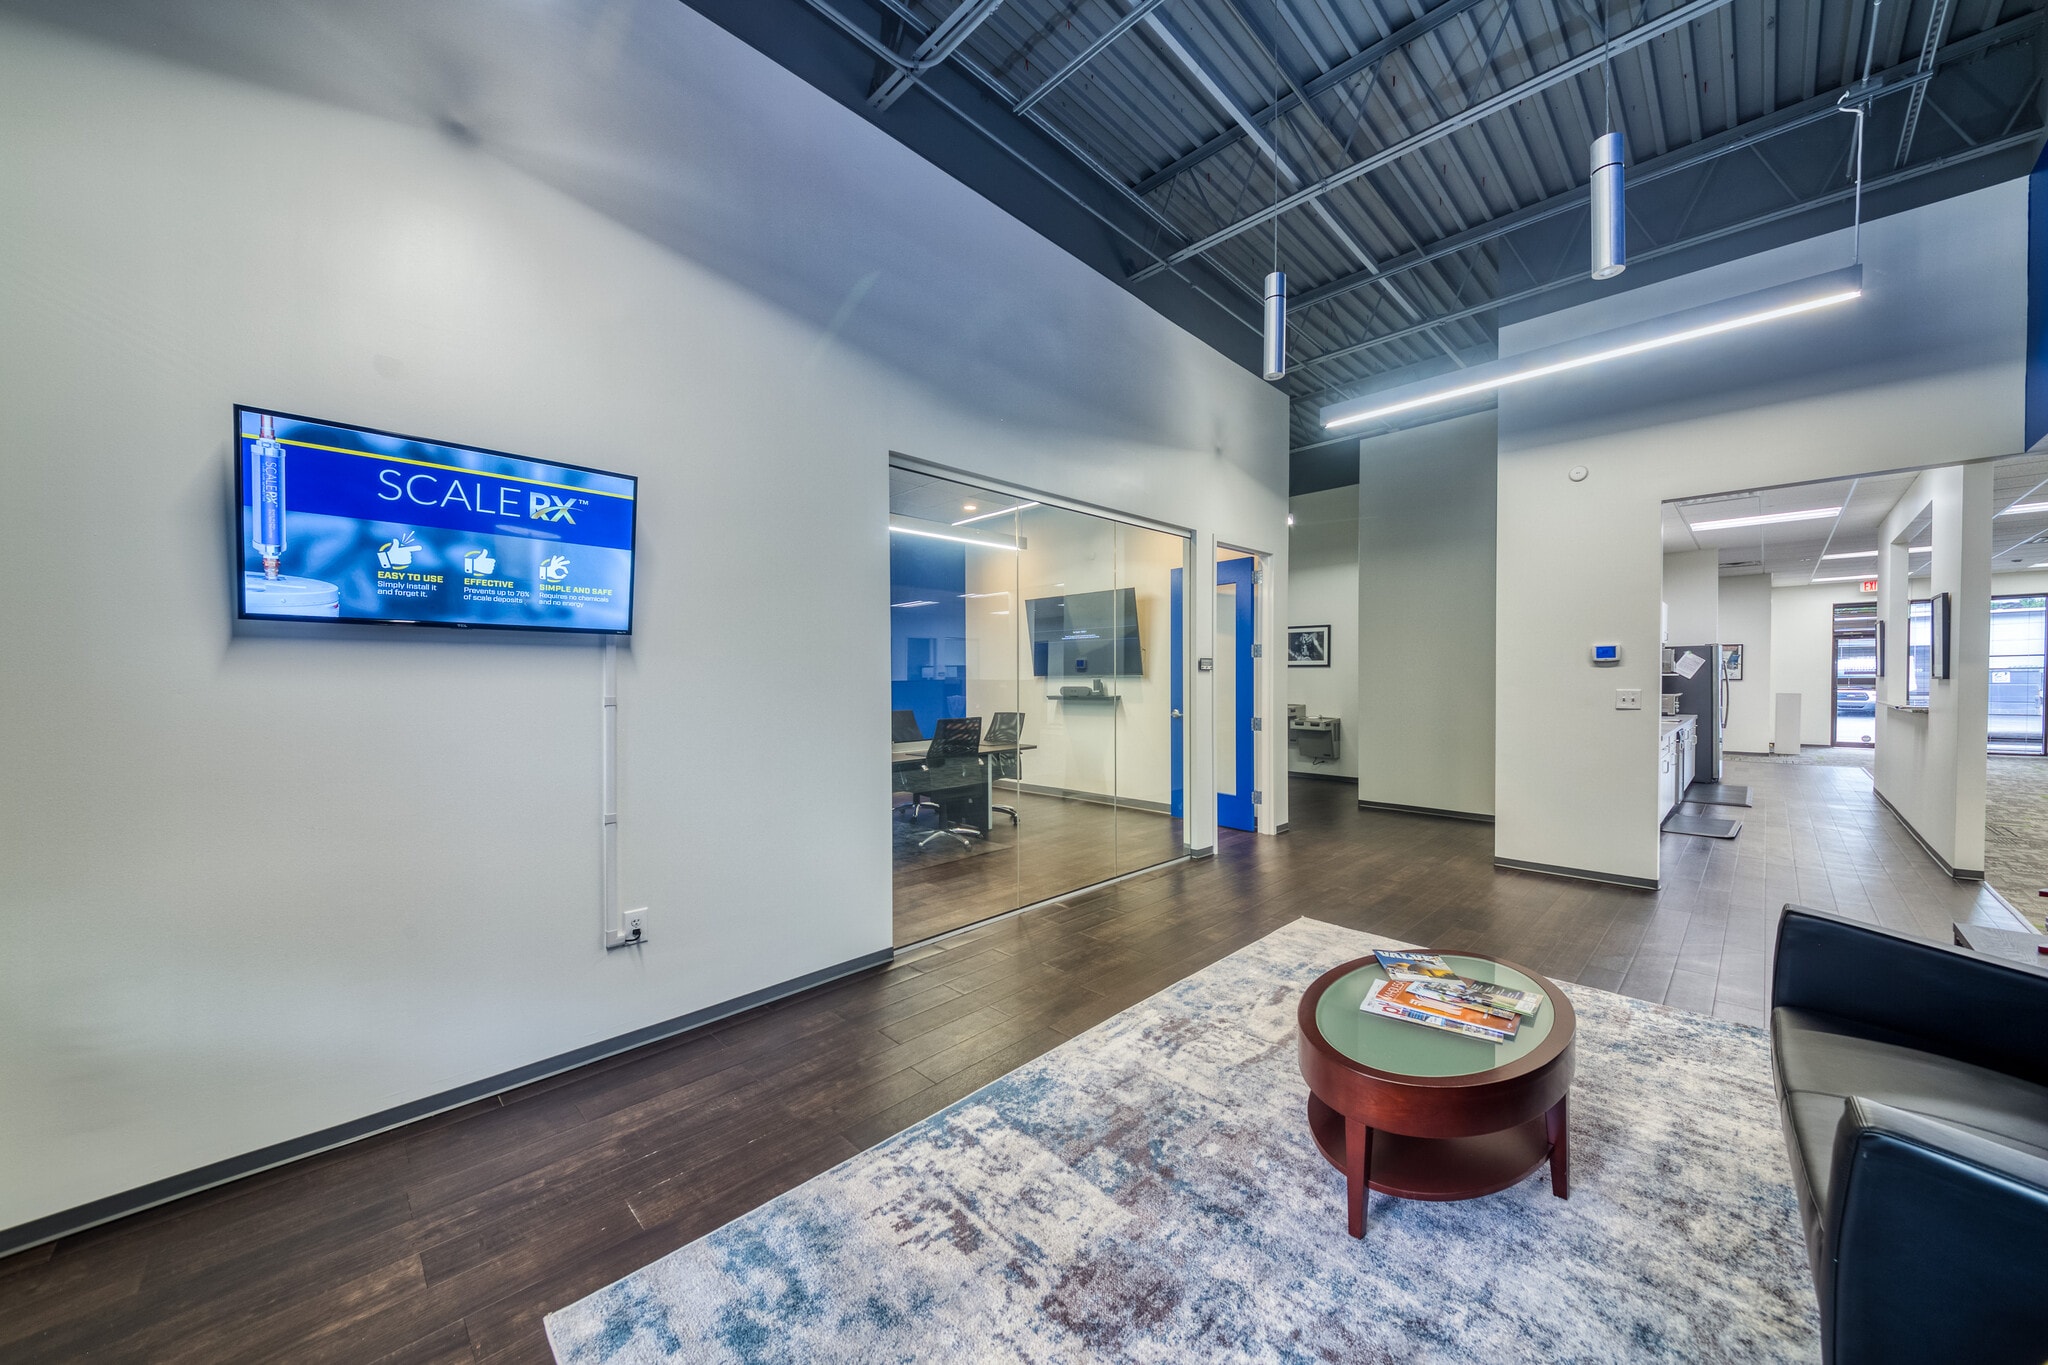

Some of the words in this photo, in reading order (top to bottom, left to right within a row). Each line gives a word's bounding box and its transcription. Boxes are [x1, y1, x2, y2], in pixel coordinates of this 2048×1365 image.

[377, 571, 405, 580] EASY
[407, 573, 421, 581] TO
[423, 574, 444, 583] USE
[377, 580, 405, 590] Simply
[406, 582, 430, 591] install
[463, 578, 515, 589] EFFECTIVE
[1864, 581, 1877, 591] EXI
[394, 589, 419, 598] forget
[463, 586, 496, 595] Prevents
[539, 584, 571, 593] SIMPLE
[592, 588, 613, 596] SAFE
